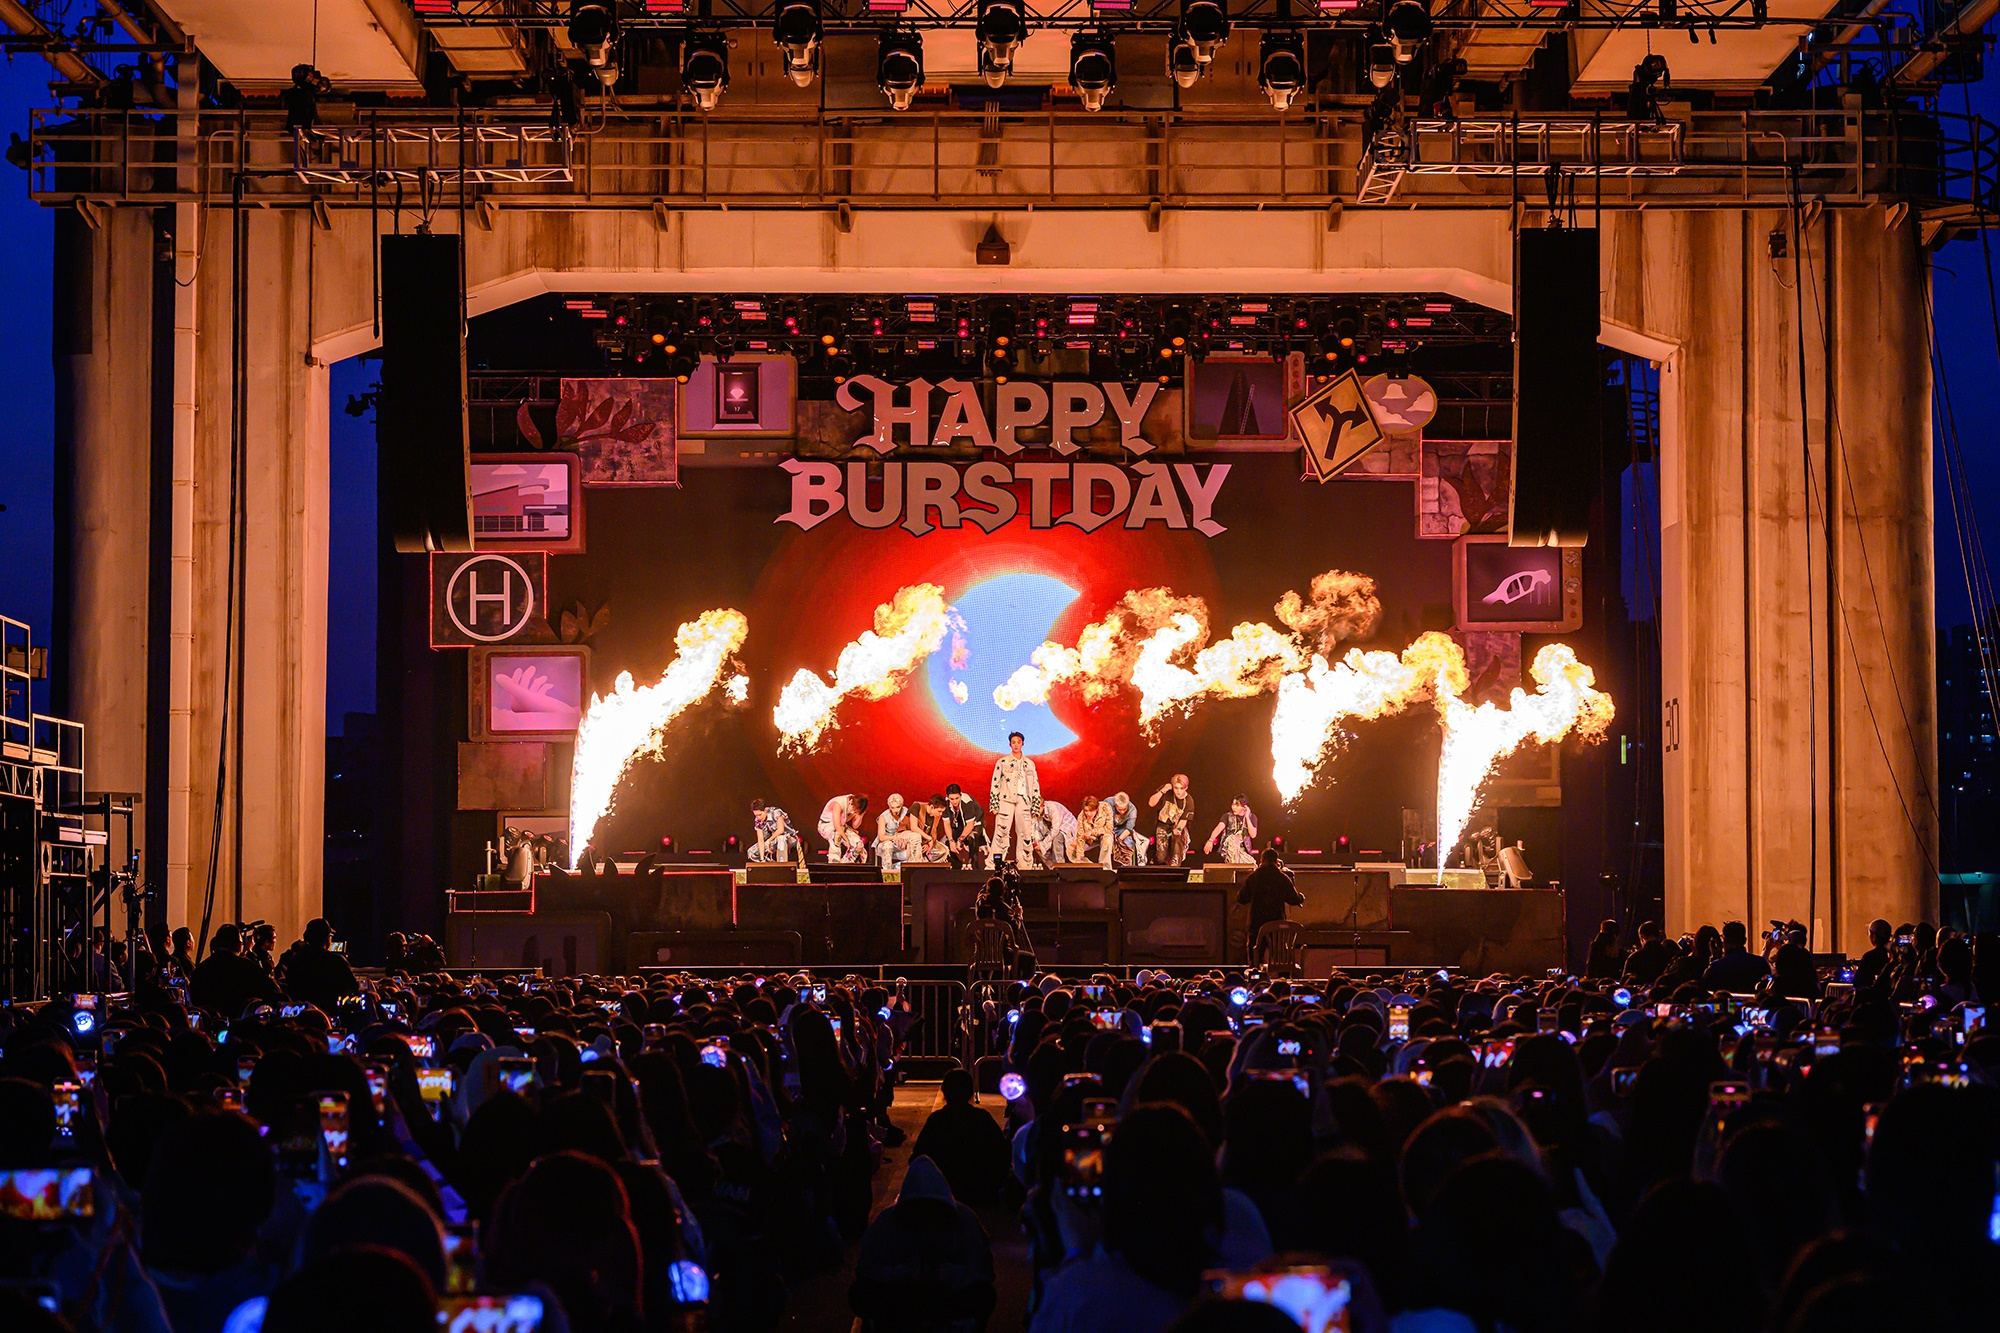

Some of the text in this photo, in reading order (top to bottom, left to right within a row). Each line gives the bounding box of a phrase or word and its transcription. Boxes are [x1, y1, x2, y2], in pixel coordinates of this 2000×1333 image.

[836, 374, 1160, 456] HAPPY
[773, 458, 1233, 538] BURSTDAY
[470, 571, 511, 625] H
[1665, 698, 1680, 753] 30
